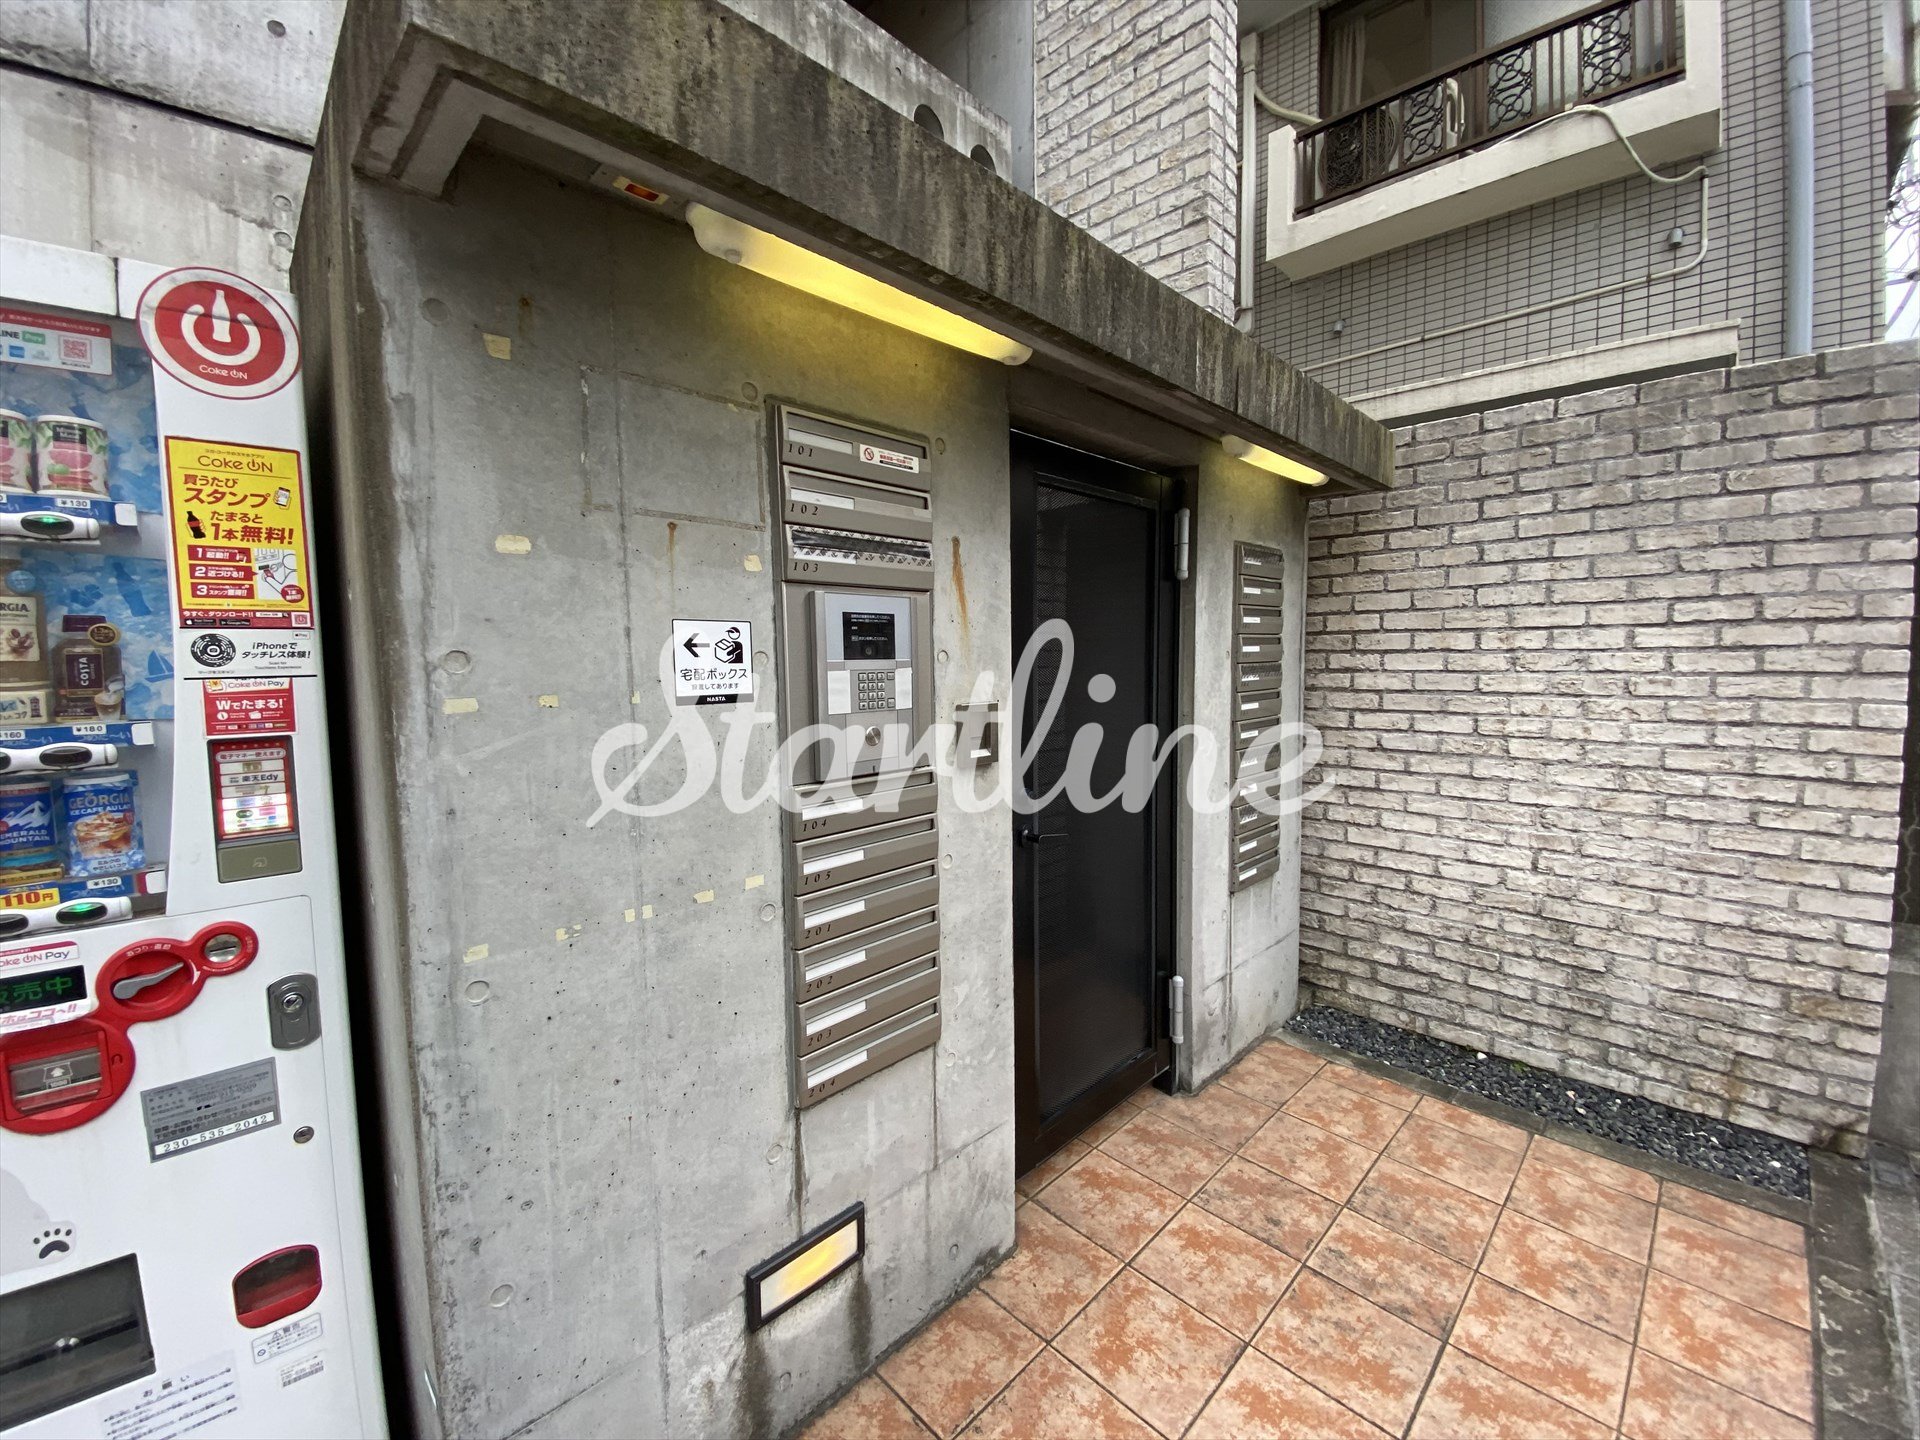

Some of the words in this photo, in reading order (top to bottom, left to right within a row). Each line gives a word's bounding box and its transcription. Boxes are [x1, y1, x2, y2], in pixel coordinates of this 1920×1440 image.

[199, 364, 229, 377] Coke
[230, 369, 248, 380] ON
[789, 443, 813, 457] 101
[197, 455, 244, 470] Coke
[246, 459, 273, 473] ON
[183, 473, 239, 489] 買うたび
[183, 487, 271, 509] スタンプ
[790, 503, 819, 515] 102
[210, 510, 263, 525] たまると
[194, 566, 206, 577] 2
[793, 562, 819, 572] 103
[196, 584, 208, 596] 3
[79, 657, 90, 686] COSTA
[680, 668, 748, 681] 宅配ボックス
[267, 680, 284, 688] Pay
[802, 819, 828, 832] 104
[803, 871, 831, 886] 105
[2, 891, 54, 907] 110円
[804, 924, 832, 940] 201
[45, 950, 70, 960] Pay
[806, 976, 833, 993] 202
[807, 1030, 832, 1047] 203
[808, 1079, 836, 1098] 204
[163, 1115, 267, 1152] 230-535-2042
